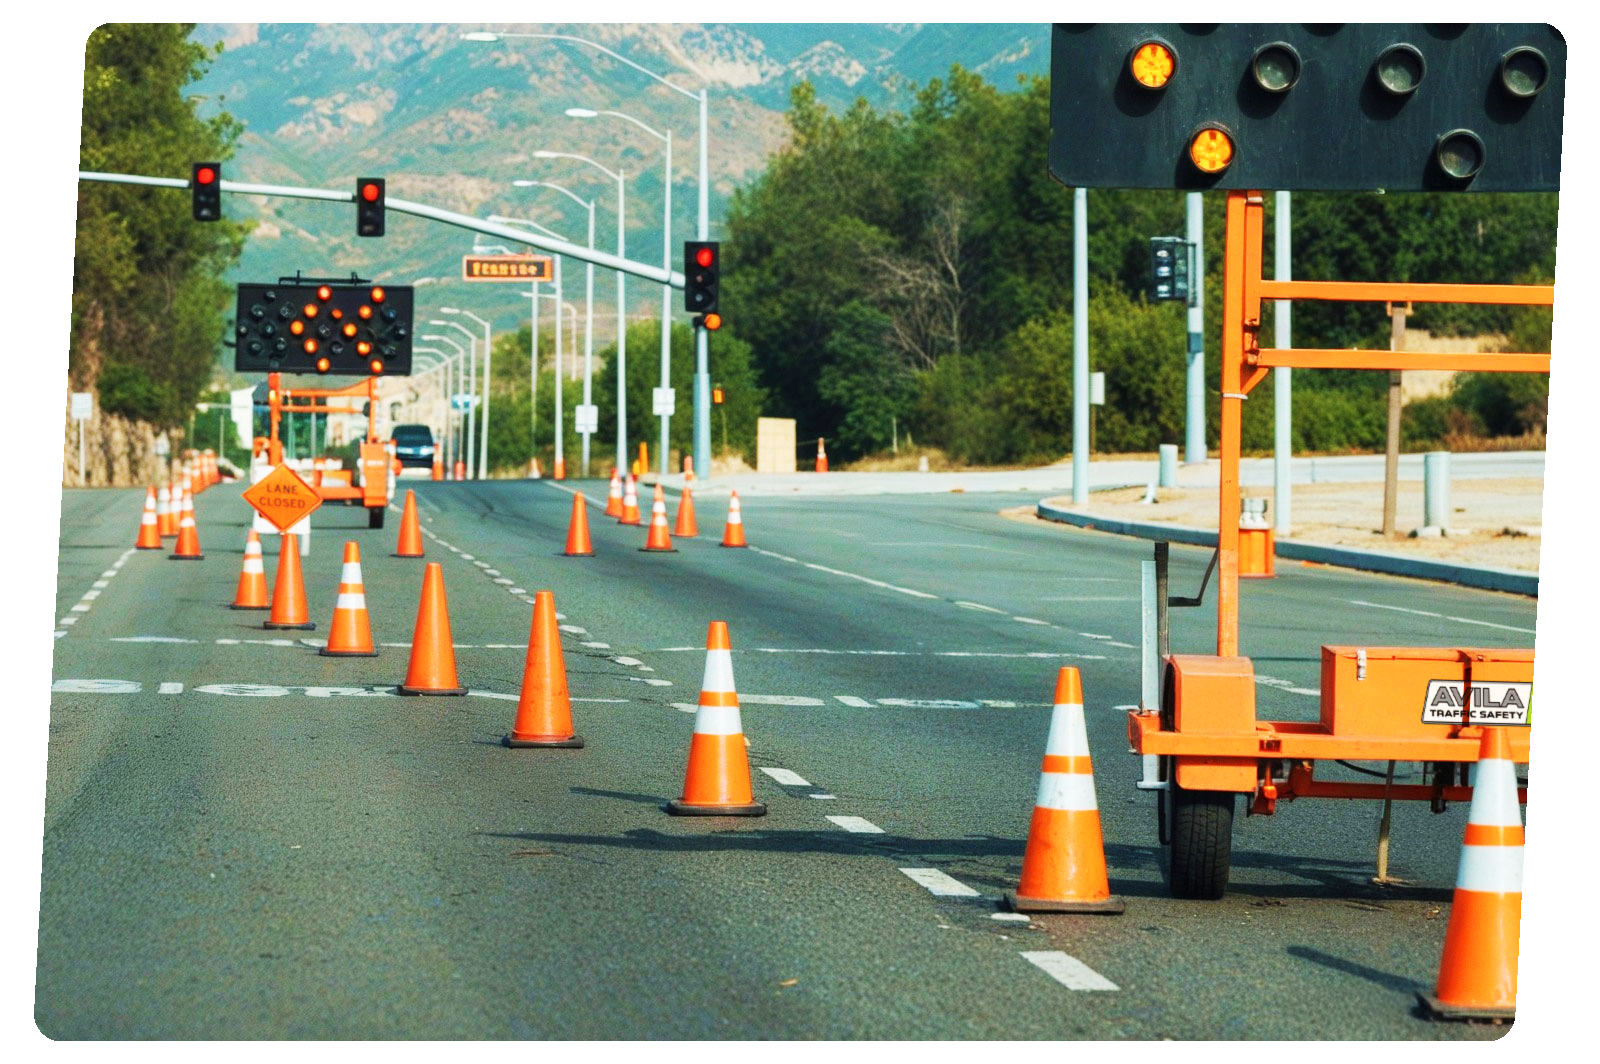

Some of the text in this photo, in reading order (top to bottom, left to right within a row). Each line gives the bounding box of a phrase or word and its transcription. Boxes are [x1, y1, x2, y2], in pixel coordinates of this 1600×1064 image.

[267, 484, 297, 494] LANE
[259, 497, 305, 508] CLOSED
[1431, 686, 1524, 708] AVILA
[1430, 709, 1523, 719] TRAFFIC SAFETY
